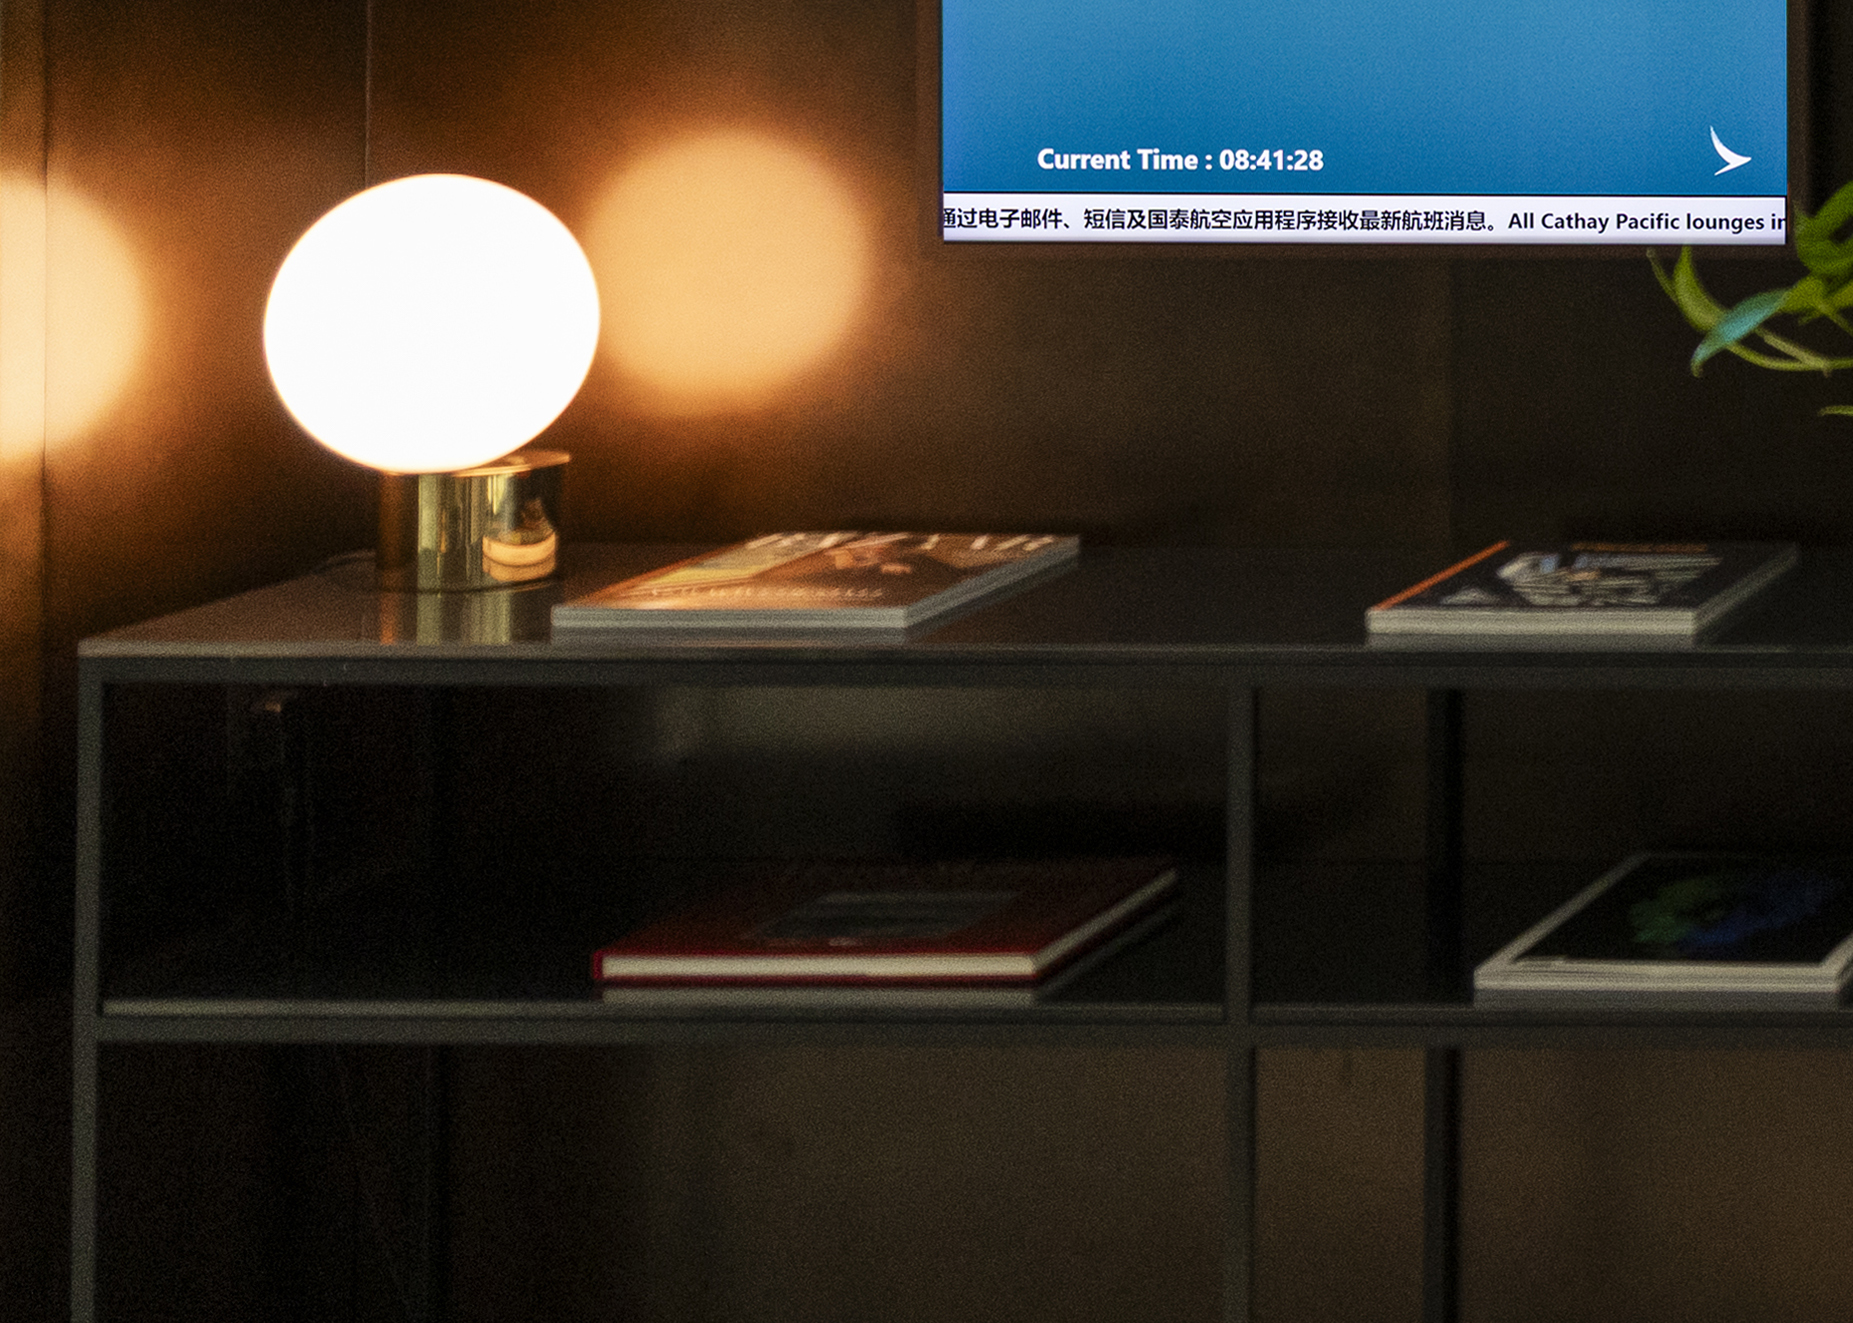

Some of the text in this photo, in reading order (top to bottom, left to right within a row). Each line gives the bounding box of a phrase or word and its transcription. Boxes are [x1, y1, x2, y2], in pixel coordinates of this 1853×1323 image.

[1038, 149, 1324, 171] Current Time : 08:41:28
[1509, 212, 1533, 229] All
[1541, 212, 1610, 234] Cathay
[1617, 212, 1680, 230] Pacific
[1686, 212, 1765, 235] lounges
